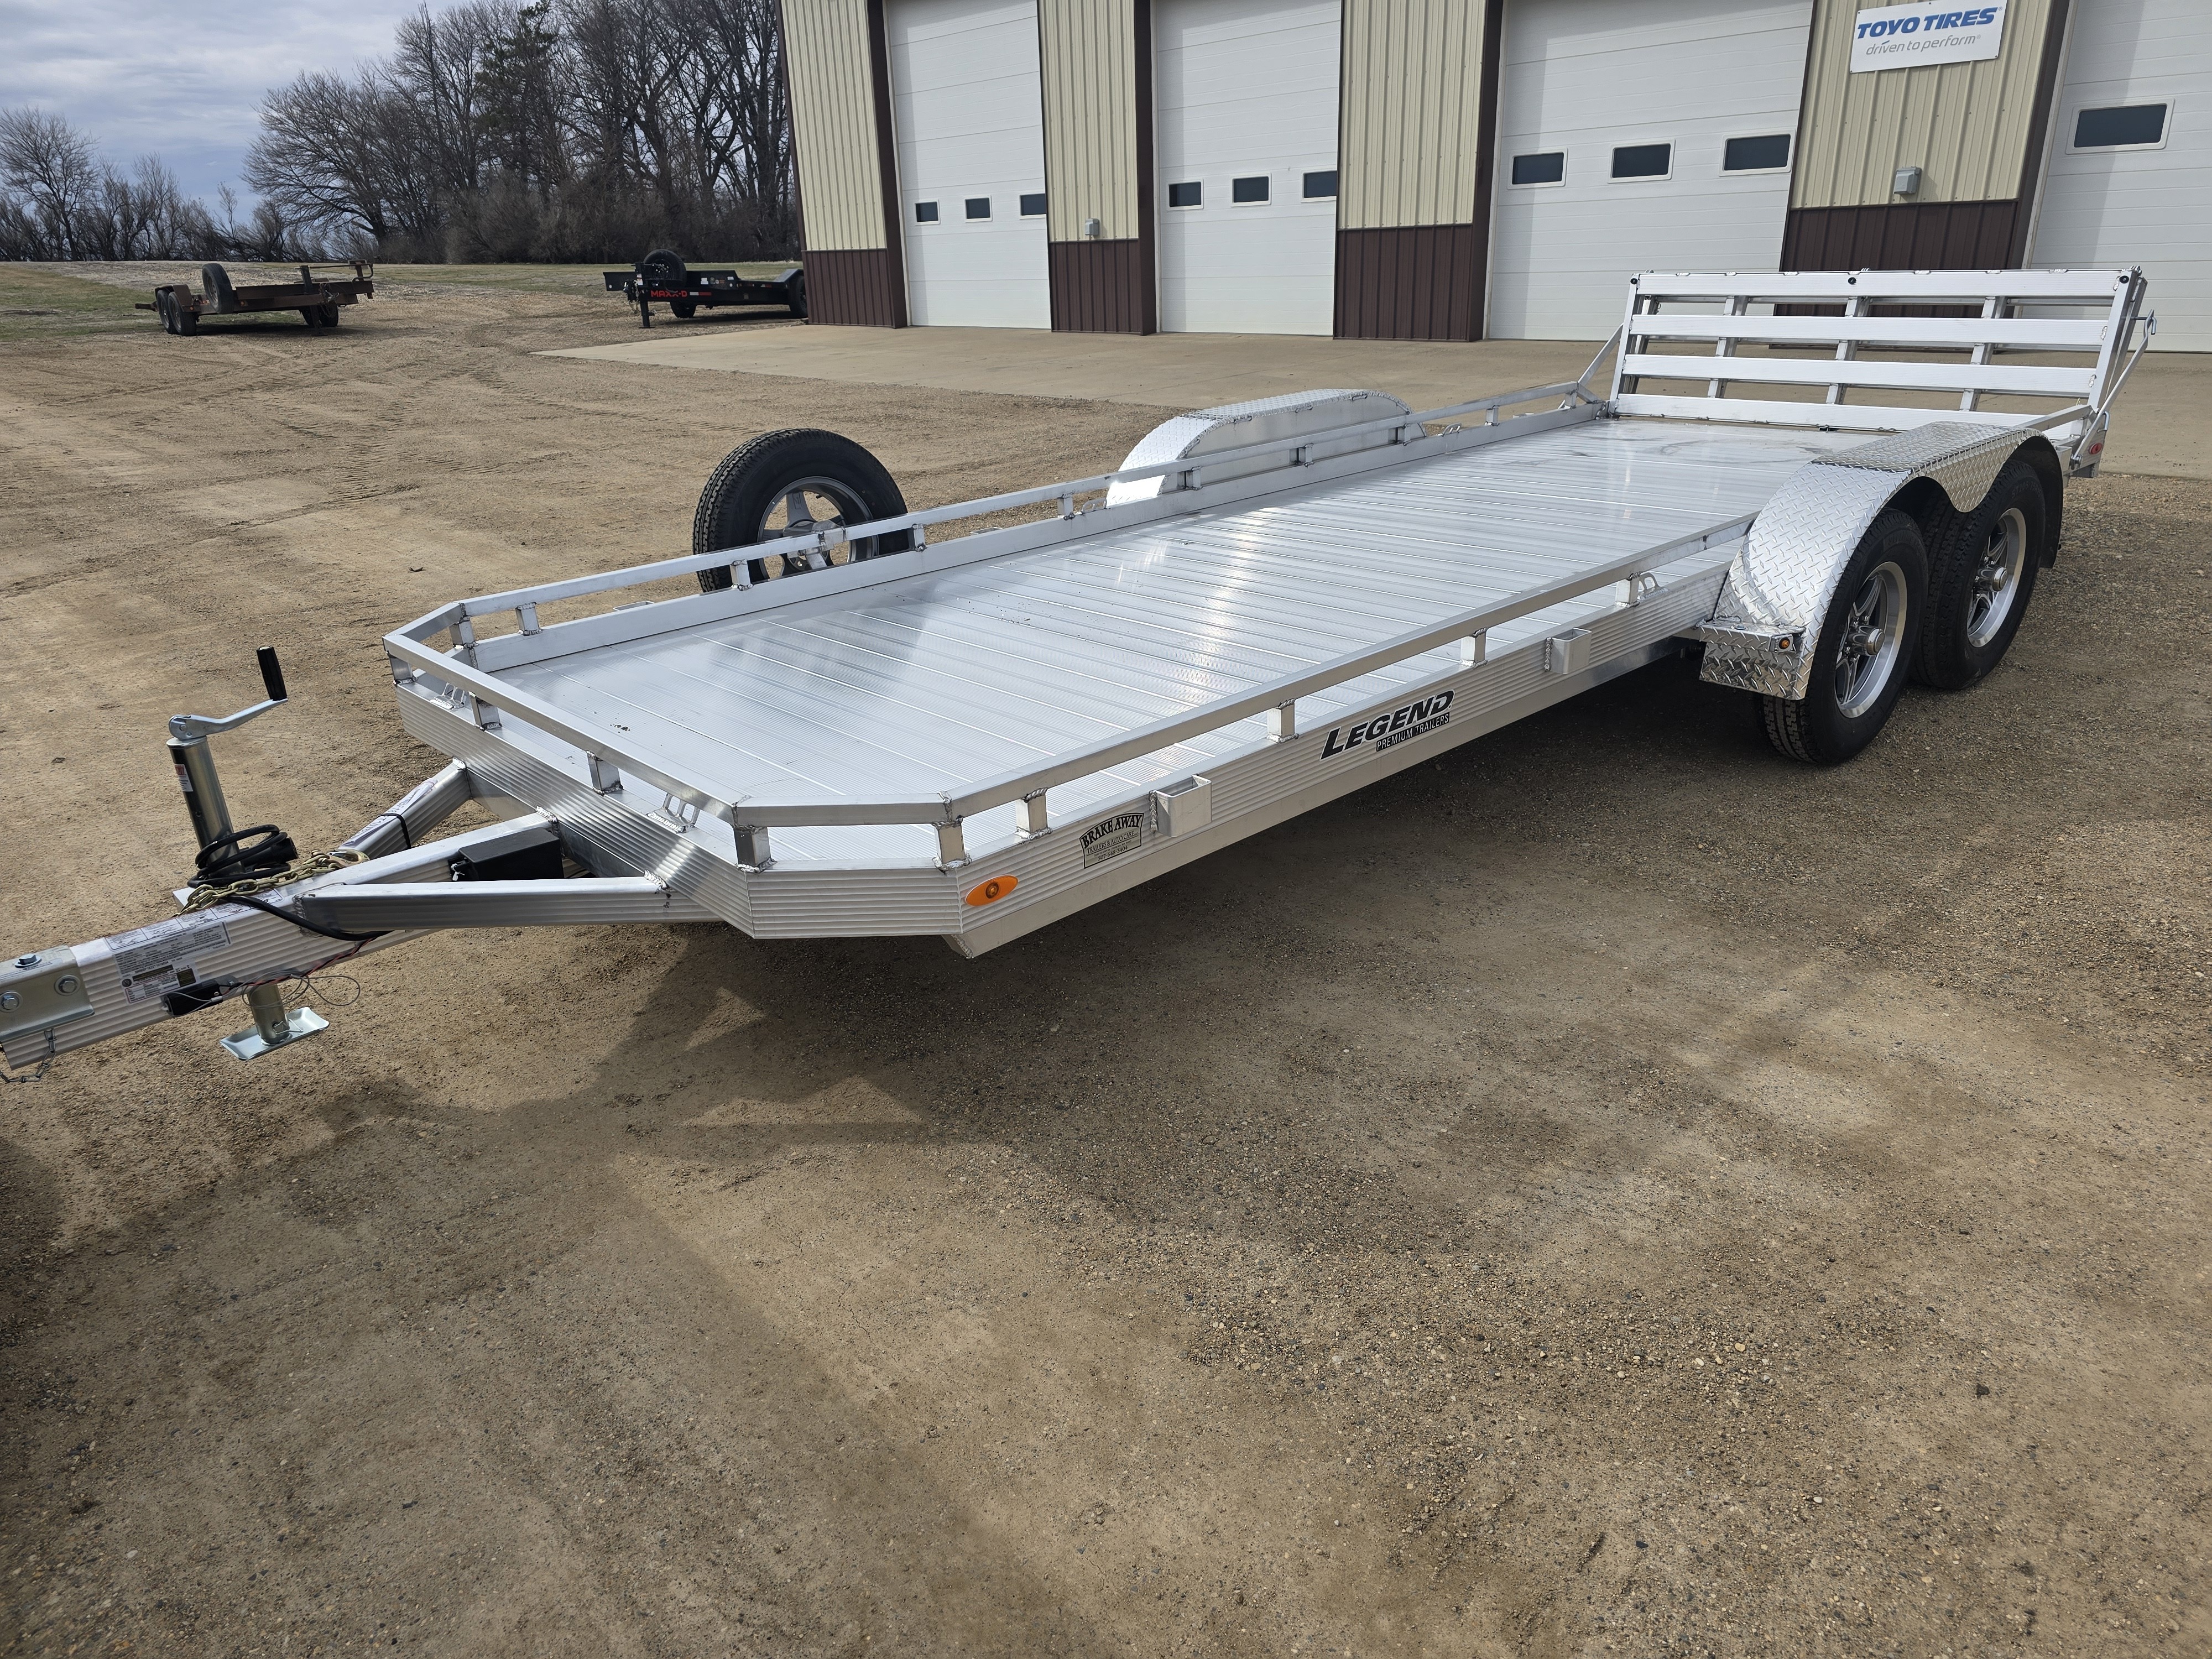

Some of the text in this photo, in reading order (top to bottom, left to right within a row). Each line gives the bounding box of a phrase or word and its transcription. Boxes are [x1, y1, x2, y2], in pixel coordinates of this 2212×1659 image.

[1858, 7, 1998, 39] TOYO TIRES
[1866, 35, 1976, 55] driven to perform
[1320, 690, 1454, 760] LEGEND
[1377, 713, 1449, 751] PREMIUM TRAILERS
[1081, 819, 1113, 849] BRAKE
[1114, 815, 1142, 831] AWAY
[1087, 841, 1107, 854] TRAILERS
[1110, 835, 1123, 845] AUTO
[1123, 831, 1135, 839] CARE
